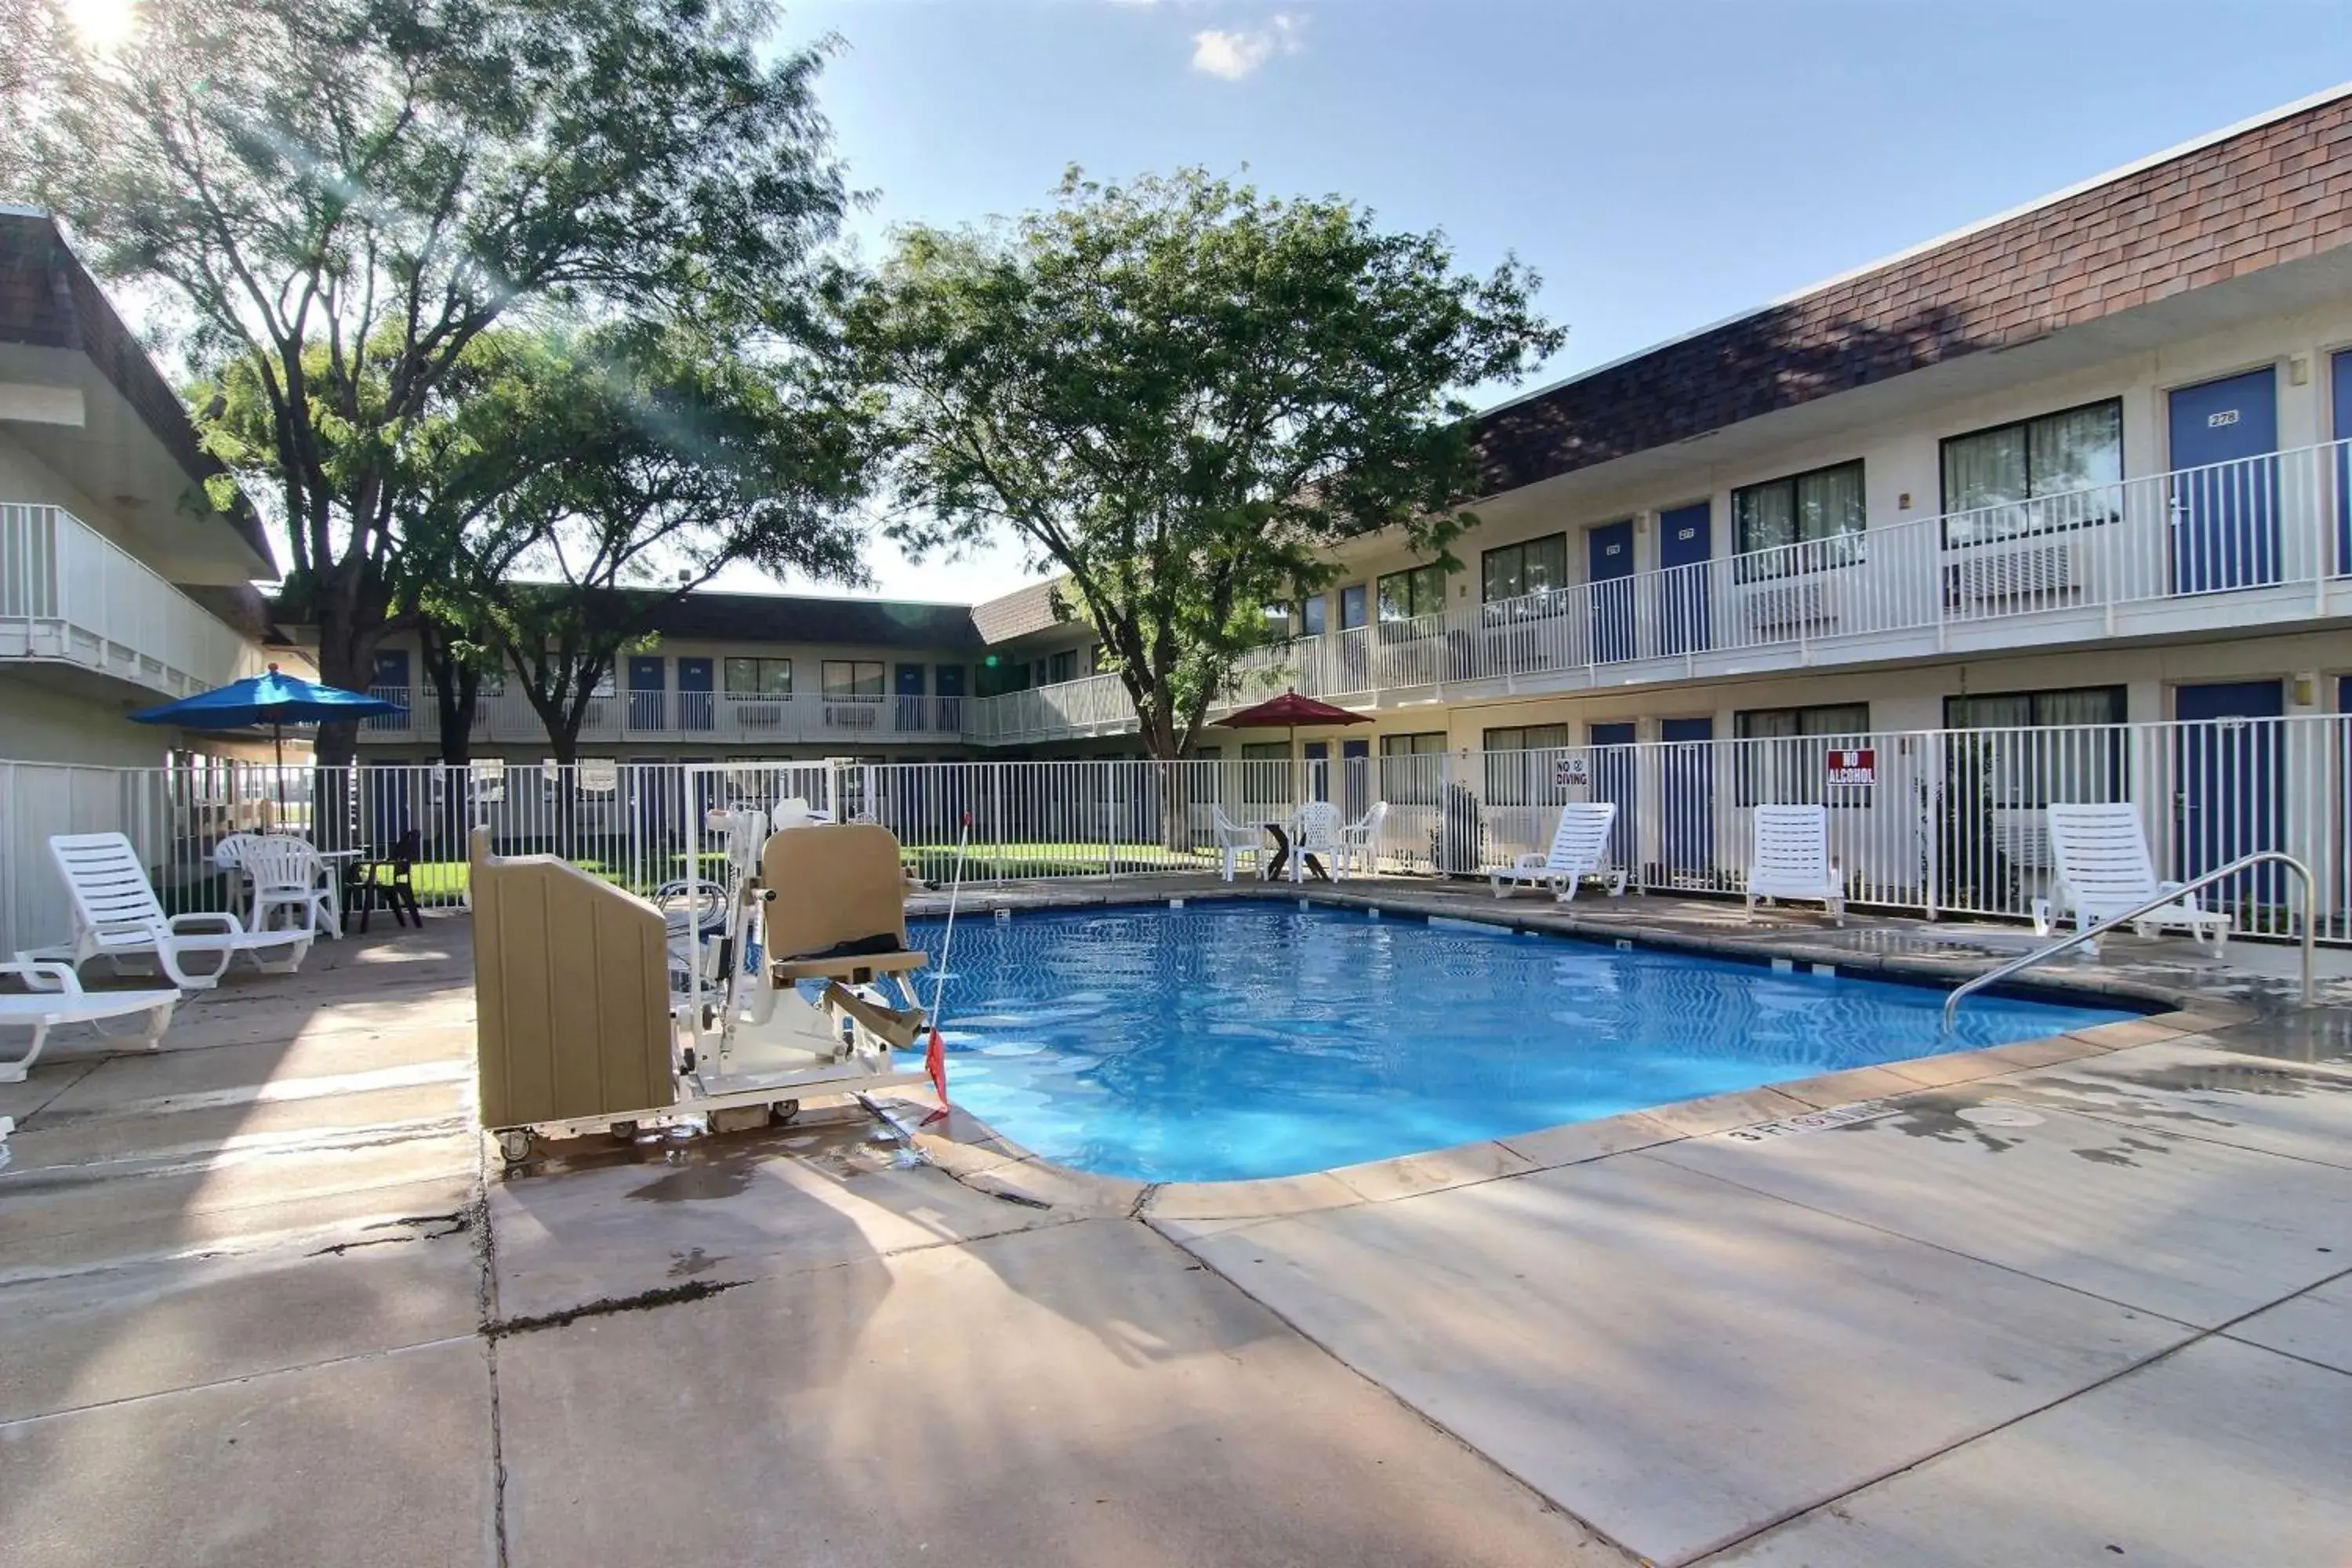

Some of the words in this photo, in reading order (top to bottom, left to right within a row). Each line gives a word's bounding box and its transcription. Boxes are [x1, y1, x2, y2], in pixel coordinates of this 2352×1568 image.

[1843, 752, 1858, 767] NO
[1556, 760, 1570, 772] NO
[1556, 773, 1587, 785] DIVING
[1829, 768, 1875, 783] ALCOHOL
[1728, 1131, 1762, 1142] 3
